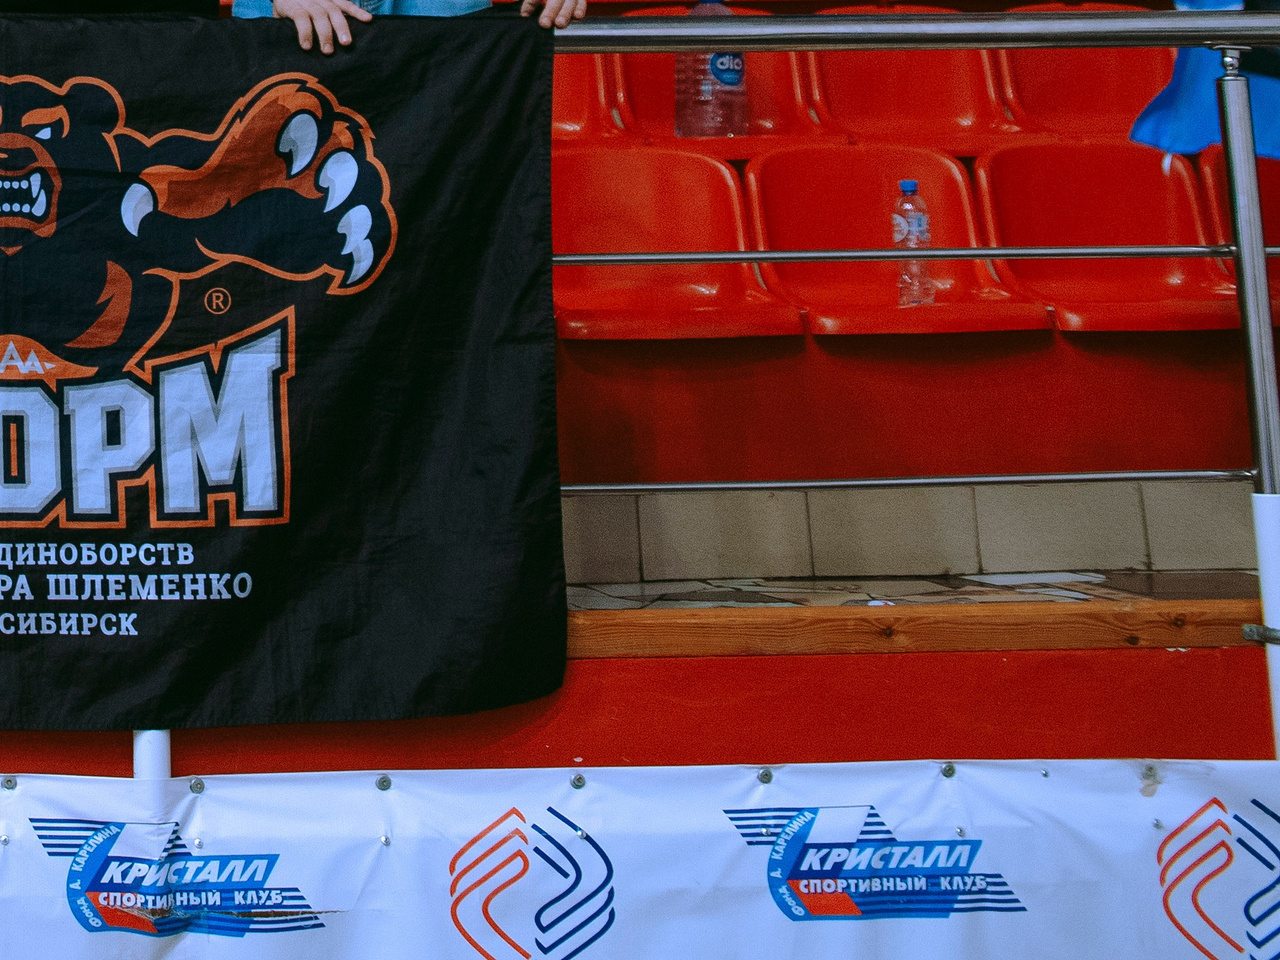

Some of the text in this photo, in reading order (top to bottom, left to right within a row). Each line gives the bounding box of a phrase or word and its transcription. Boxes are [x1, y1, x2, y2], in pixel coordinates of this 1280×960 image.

[46, 572, 253, 600] ШЛЕМЕНКО
[71, 825, 121, 872] КАРЕЛИНА
[771, 811, 815, 860] КАРЕЛИНА
[799, 845, 971, 871] КРИСТАЛЛ
[100, 859, 269, 887] КРИСТАЛЛ
[799, 875, 987, 894] СПОРТИВНЫЙ КЛУБ
[234, 890, 283, 906] КЛУБ
